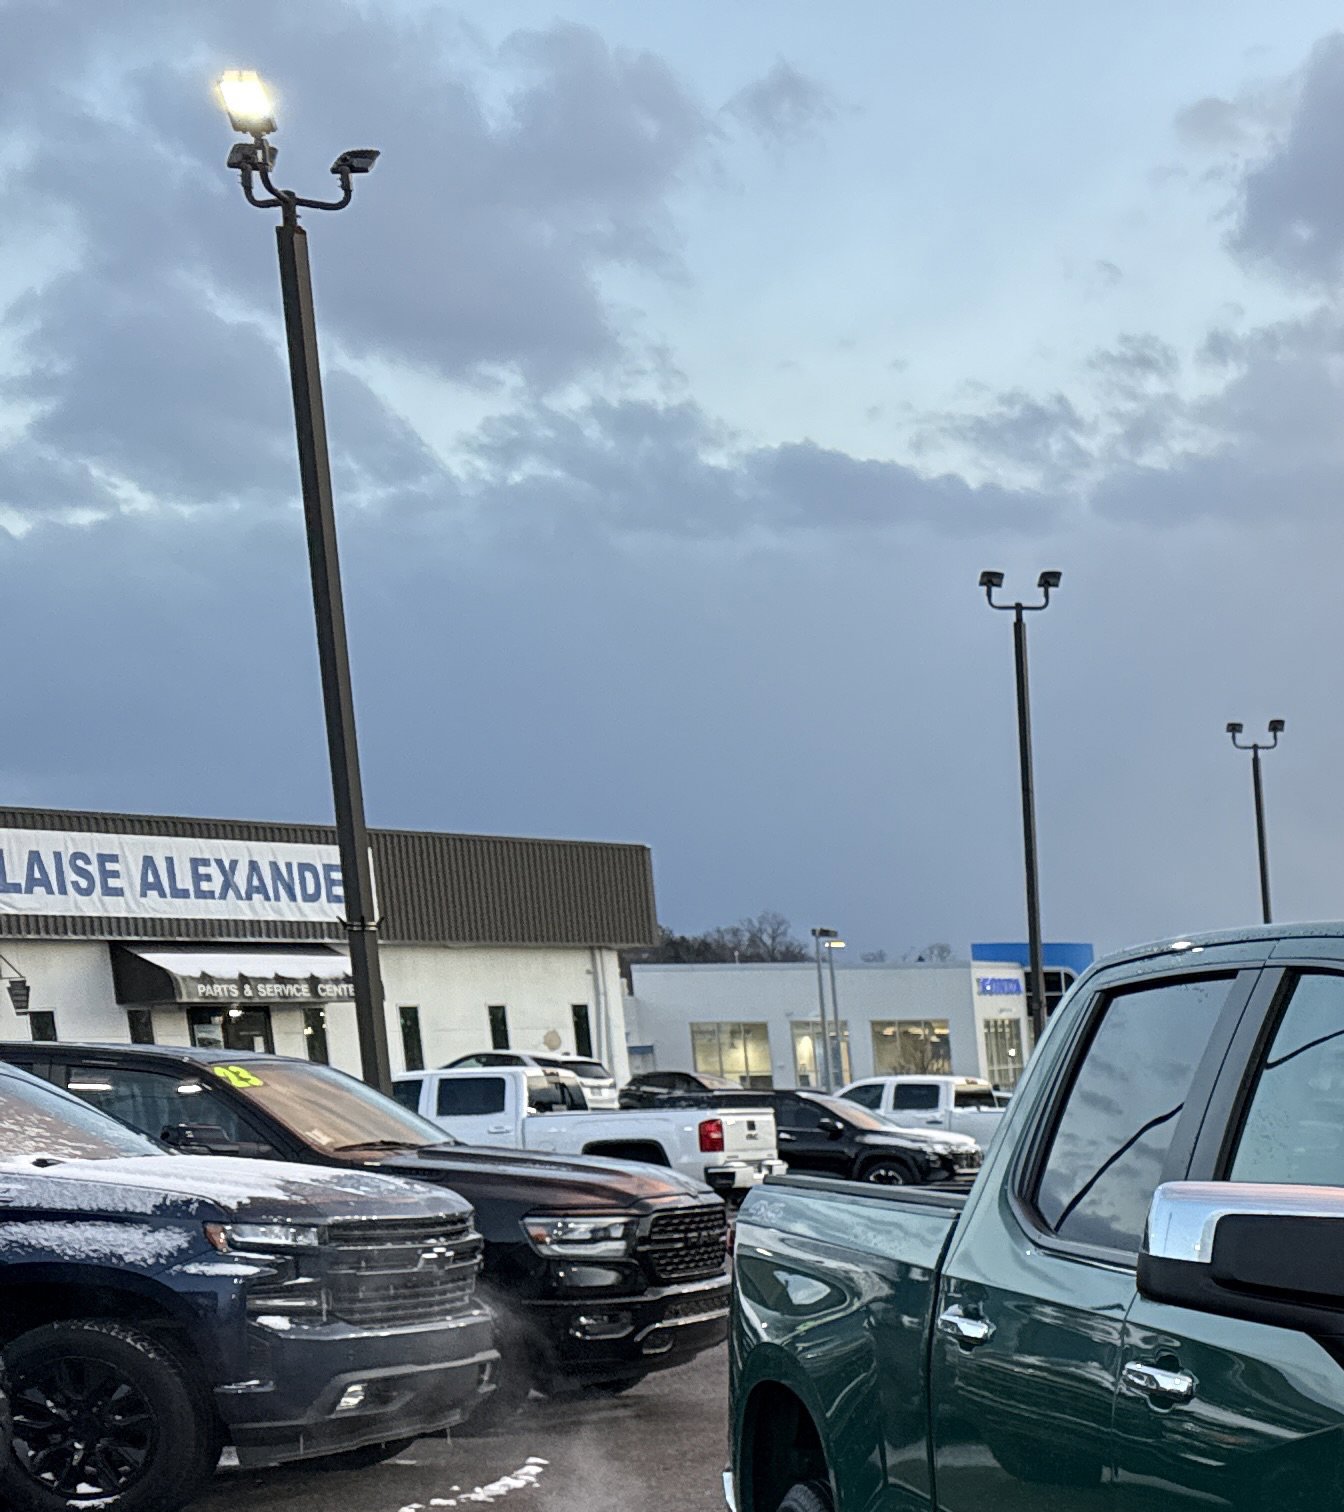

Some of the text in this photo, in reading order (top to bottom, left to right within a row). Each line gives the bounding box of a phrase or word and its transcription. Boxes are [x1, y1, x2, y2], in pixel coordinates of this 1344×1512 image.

[0, 848, 345, 904] LAISE ALEXANDE
[197, 983, 356, 998] PARTS & SERVICE CENTE
